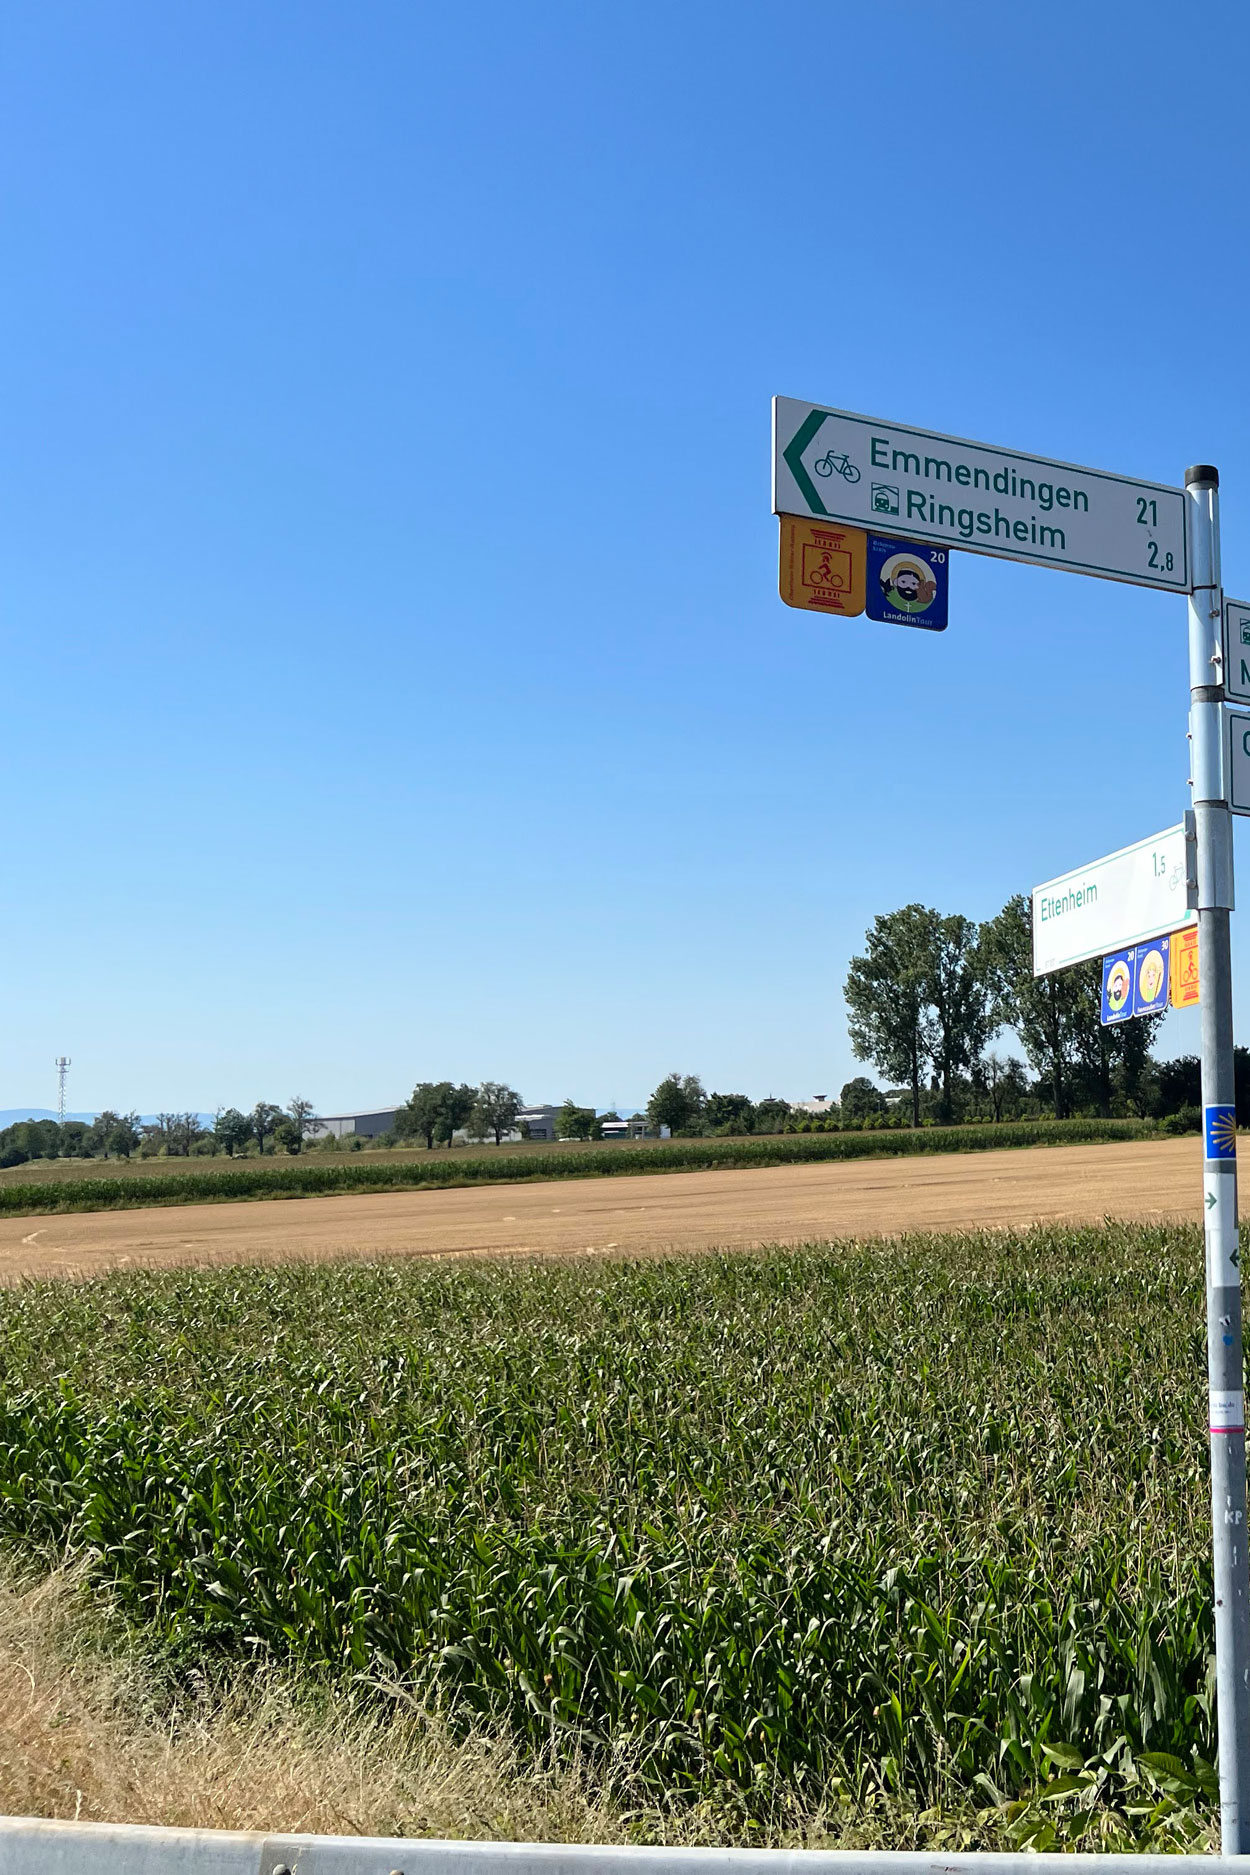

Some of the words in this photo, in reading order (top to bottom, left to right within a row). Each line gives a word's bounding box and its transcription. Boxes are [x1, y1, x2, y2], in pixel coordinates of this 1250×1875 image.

[870, 437, 1089, 512] Emmendingen
[1136, 496, 1158, 527] 21
[907, 489, 1066, 550] Ringsheim
[1147, 541, 1174, 572] 2,8
[930, 551, 946, 564] 20
[1152, 852, 1166, 878] 1,5
[1041, 882, 1098, 922] Ettenheim
